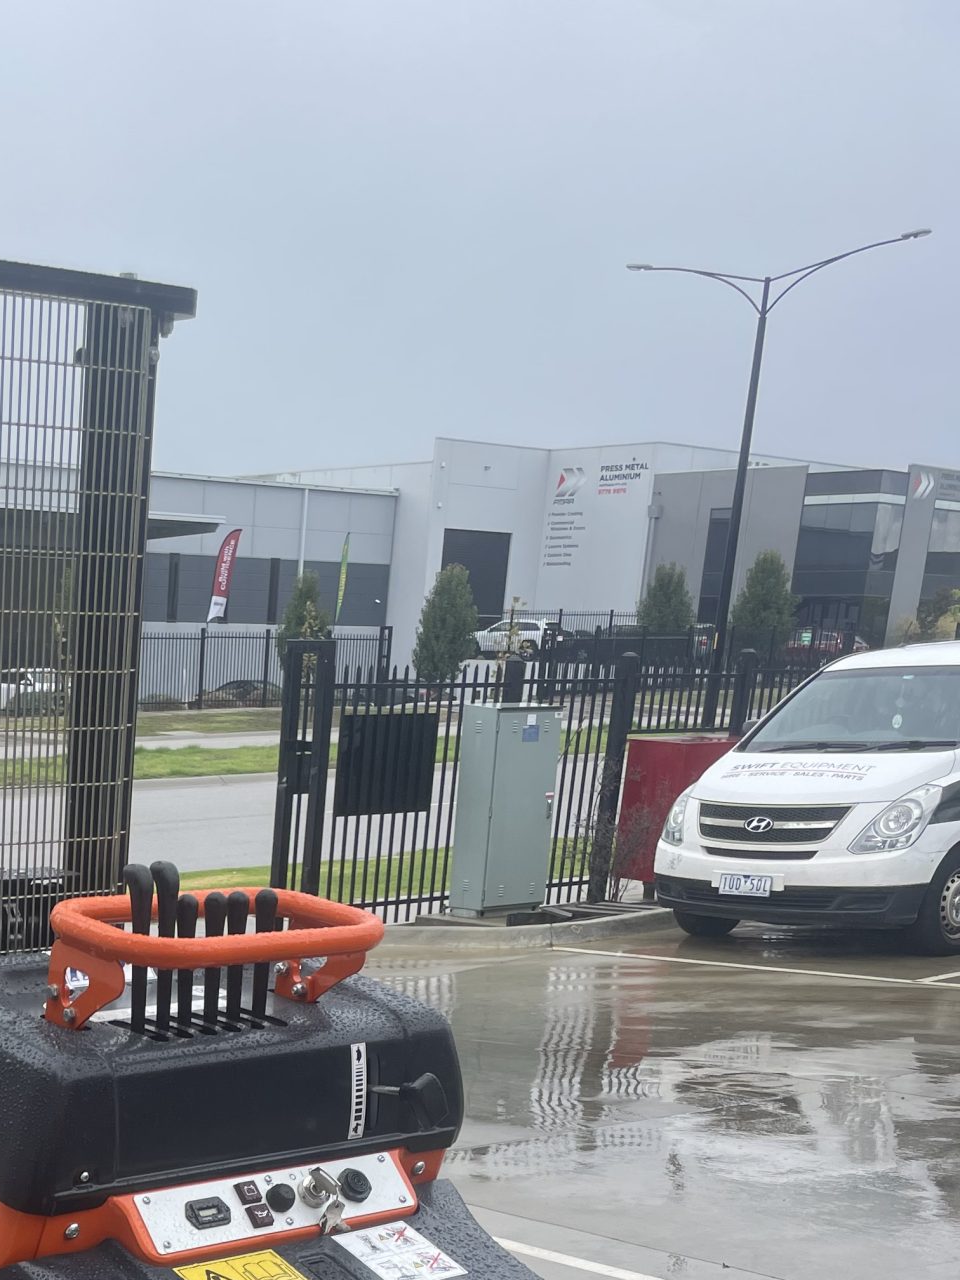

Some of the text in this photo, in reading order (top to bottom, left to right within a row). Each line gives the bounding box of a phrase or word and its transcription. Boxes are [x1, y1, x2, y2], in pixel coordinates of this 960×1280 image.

[625, 462, 649, 471] METAL
[599, 472, 641, 482] ALUMINIUM
[731, 761, 877, 772] SWIFT EQUIPMENT
[831, 773, 865, 781] PARTS
